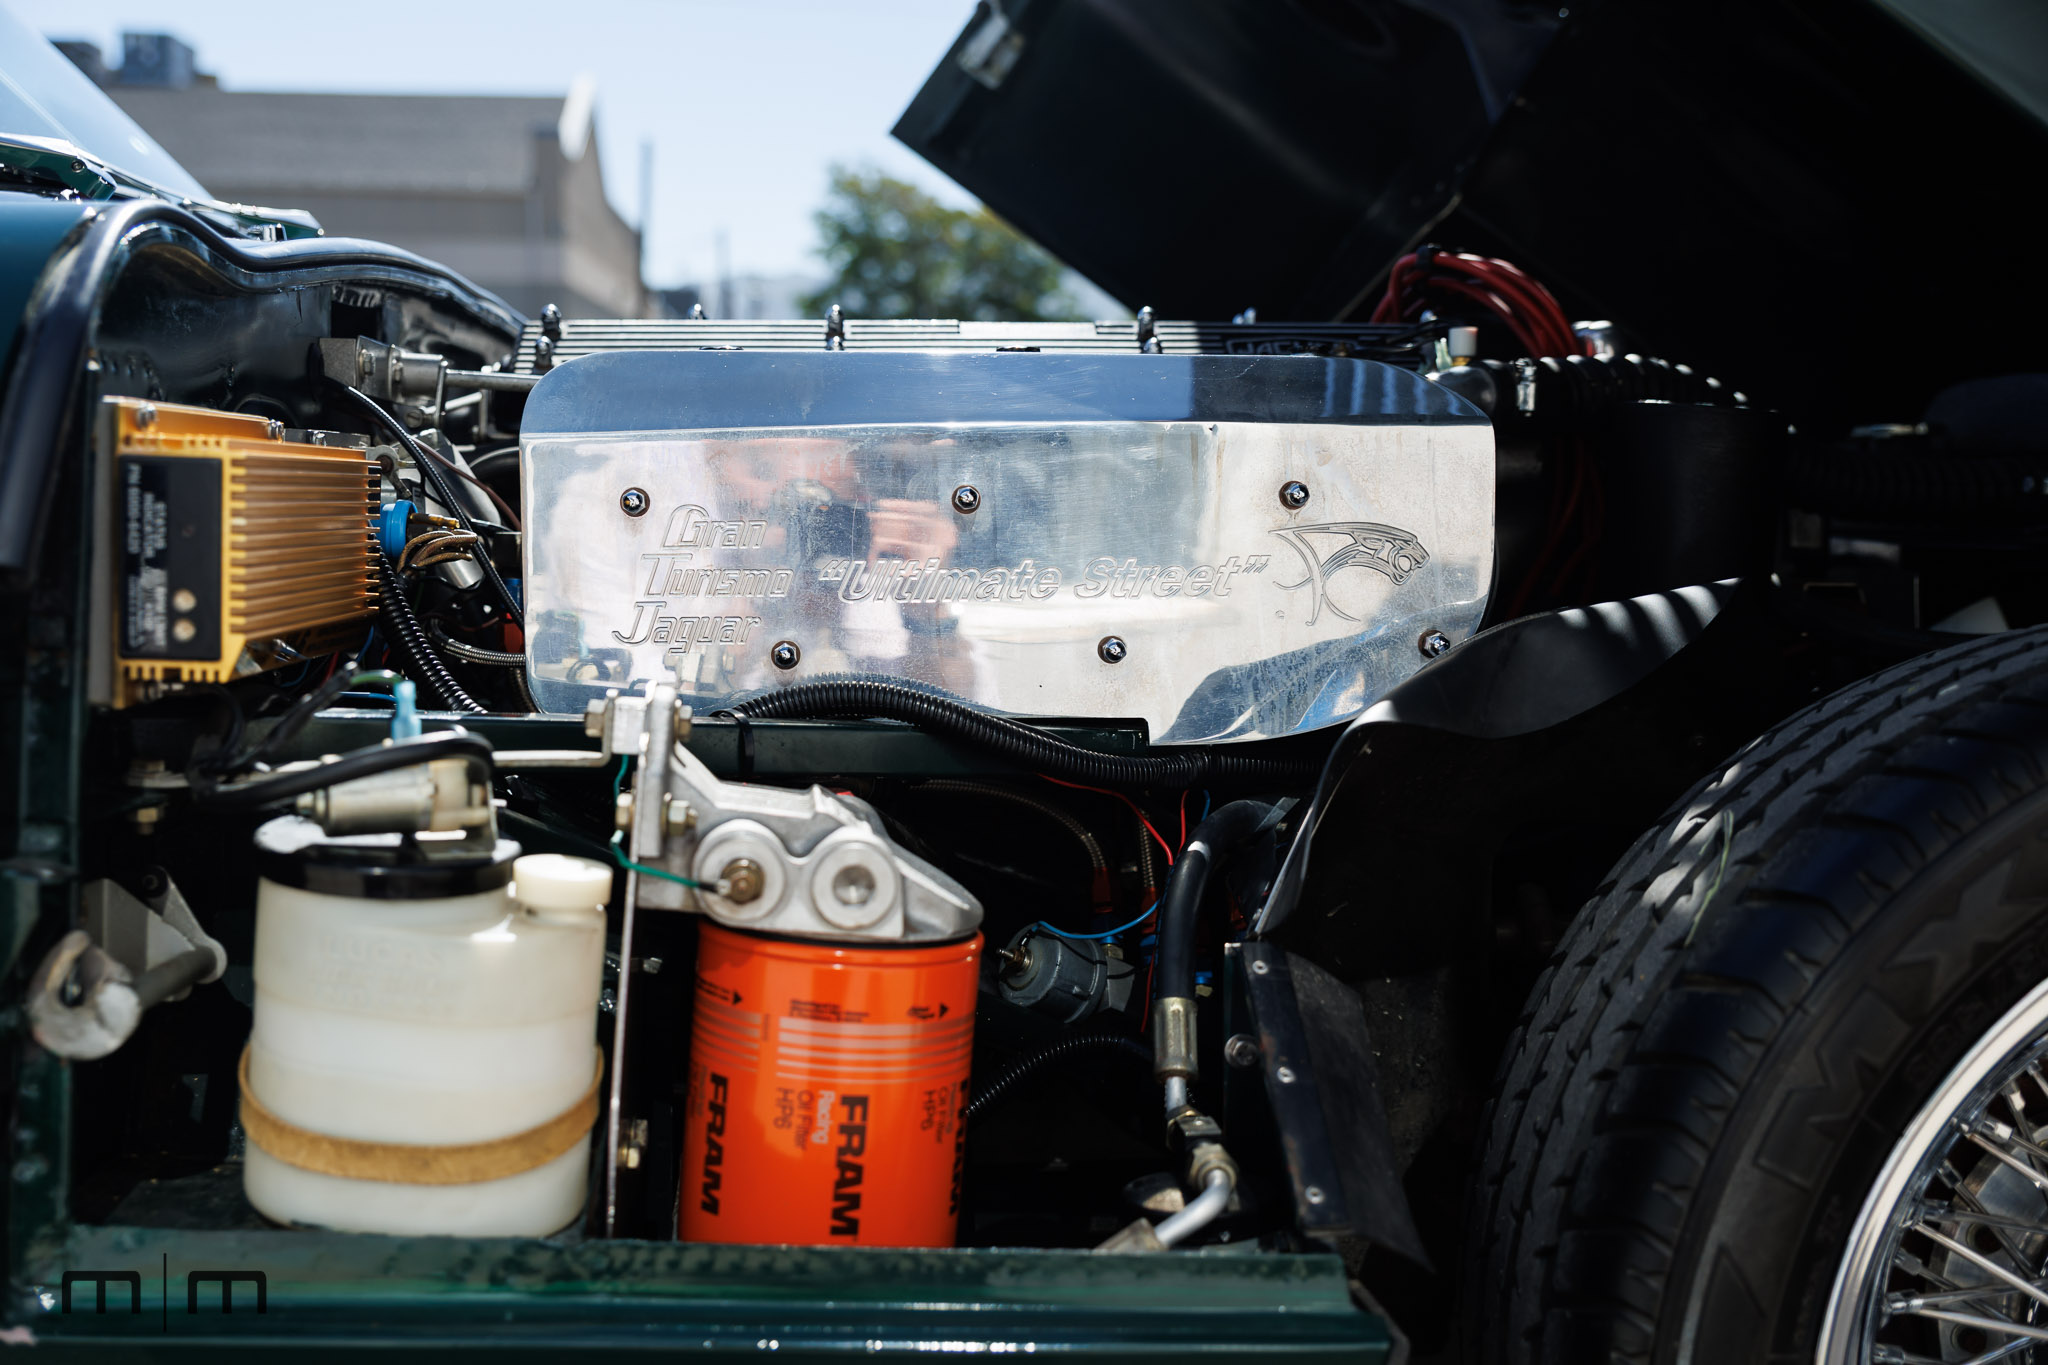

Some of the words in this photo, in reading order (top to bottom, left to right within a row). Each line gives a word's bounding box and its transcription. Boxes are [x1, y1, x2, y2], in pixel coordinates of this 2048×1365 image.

[662, 504, 768, 549] Gran
[640, 553, 794, 598] Turismo
[611, 600, 761, 654] Jaguar
[811, 1089, 836, 1144] Racing
[701, 1071, 729, 1217] FRAM
[830, 1094, 870, 1237] FRAM
